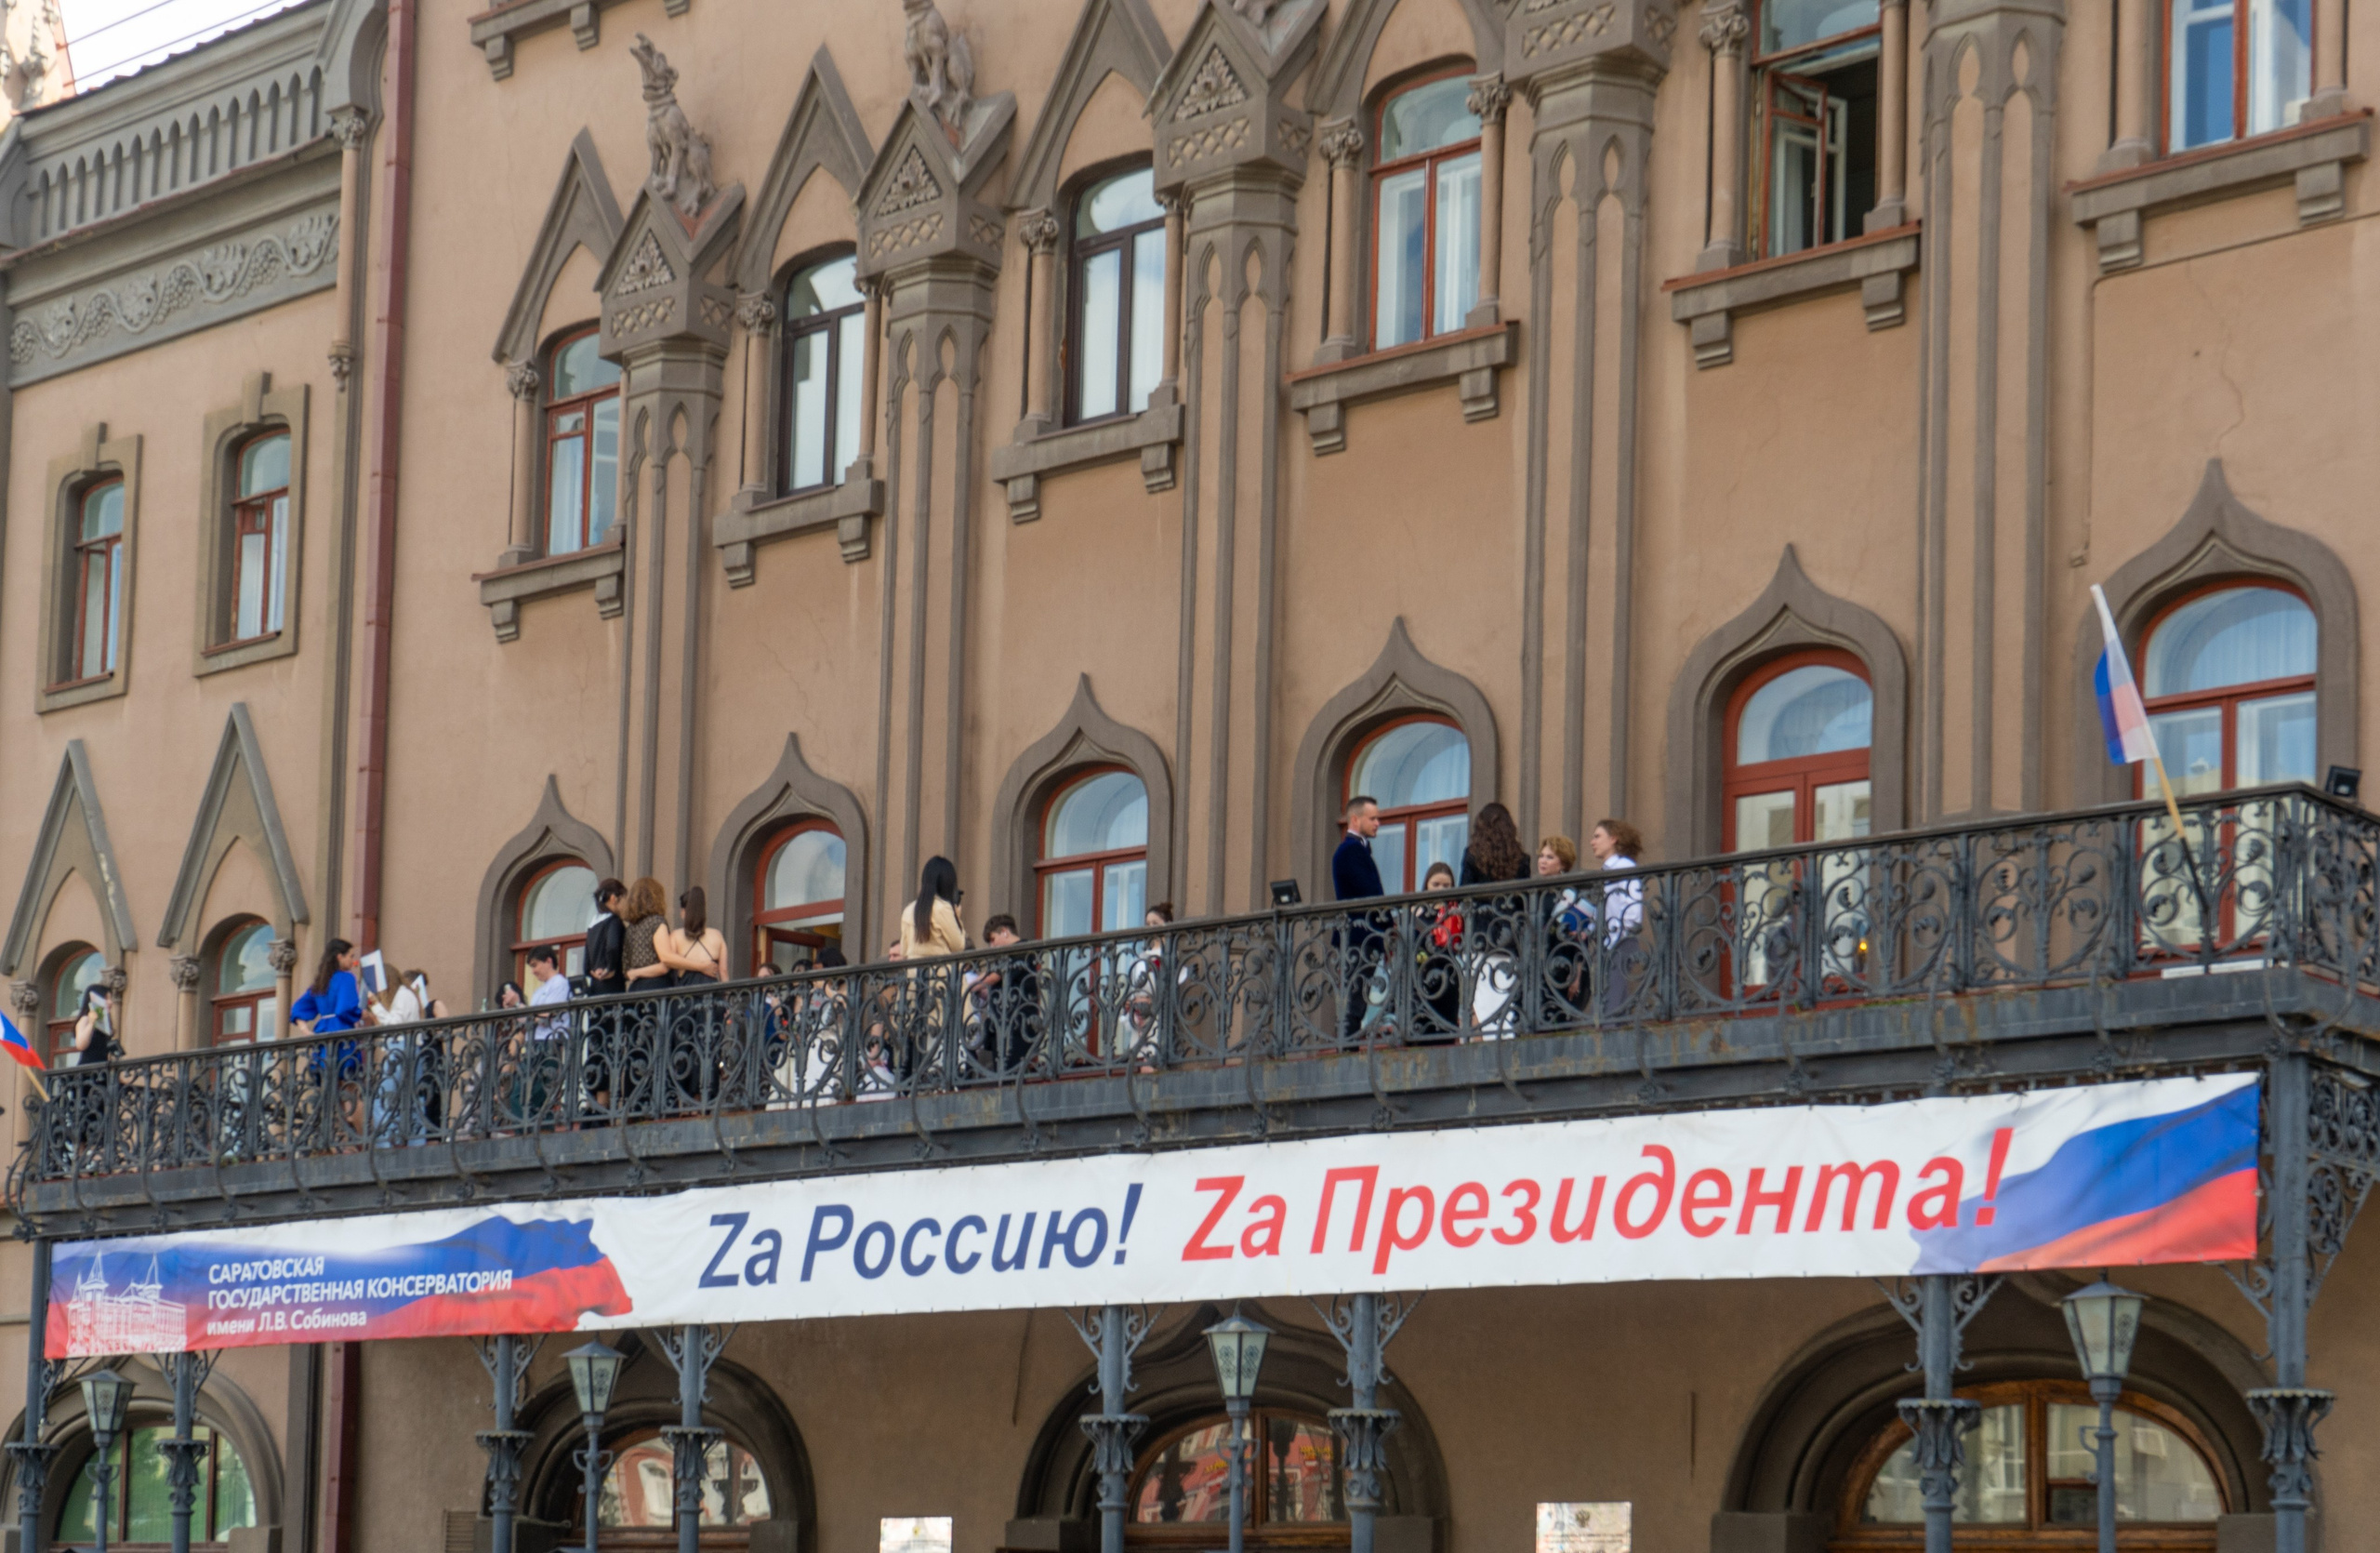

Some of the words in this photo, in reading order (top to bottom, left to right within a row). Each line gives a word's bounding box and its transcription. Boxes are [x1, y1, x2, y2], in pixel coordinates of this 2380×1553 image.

[698, 1212, 782, 1290] Za
[800, 1183, 1143, 1283] Россию!
[1183, 1175, 1287, 1261] Za
[1310, 1127, 2014, 1275] Президента!
[208, 1256, 324, 1284] САРАТОВСКАЯ
[208, 1279, 364, 1310] ГОСУДАРСТВЕННАЯ
[366, 1269, 512, 1299] КОНСЕРВАТОРИЯ
[206, 1316, 255, 1335] имени
[290, 1307, 367, 1330] Собинова
